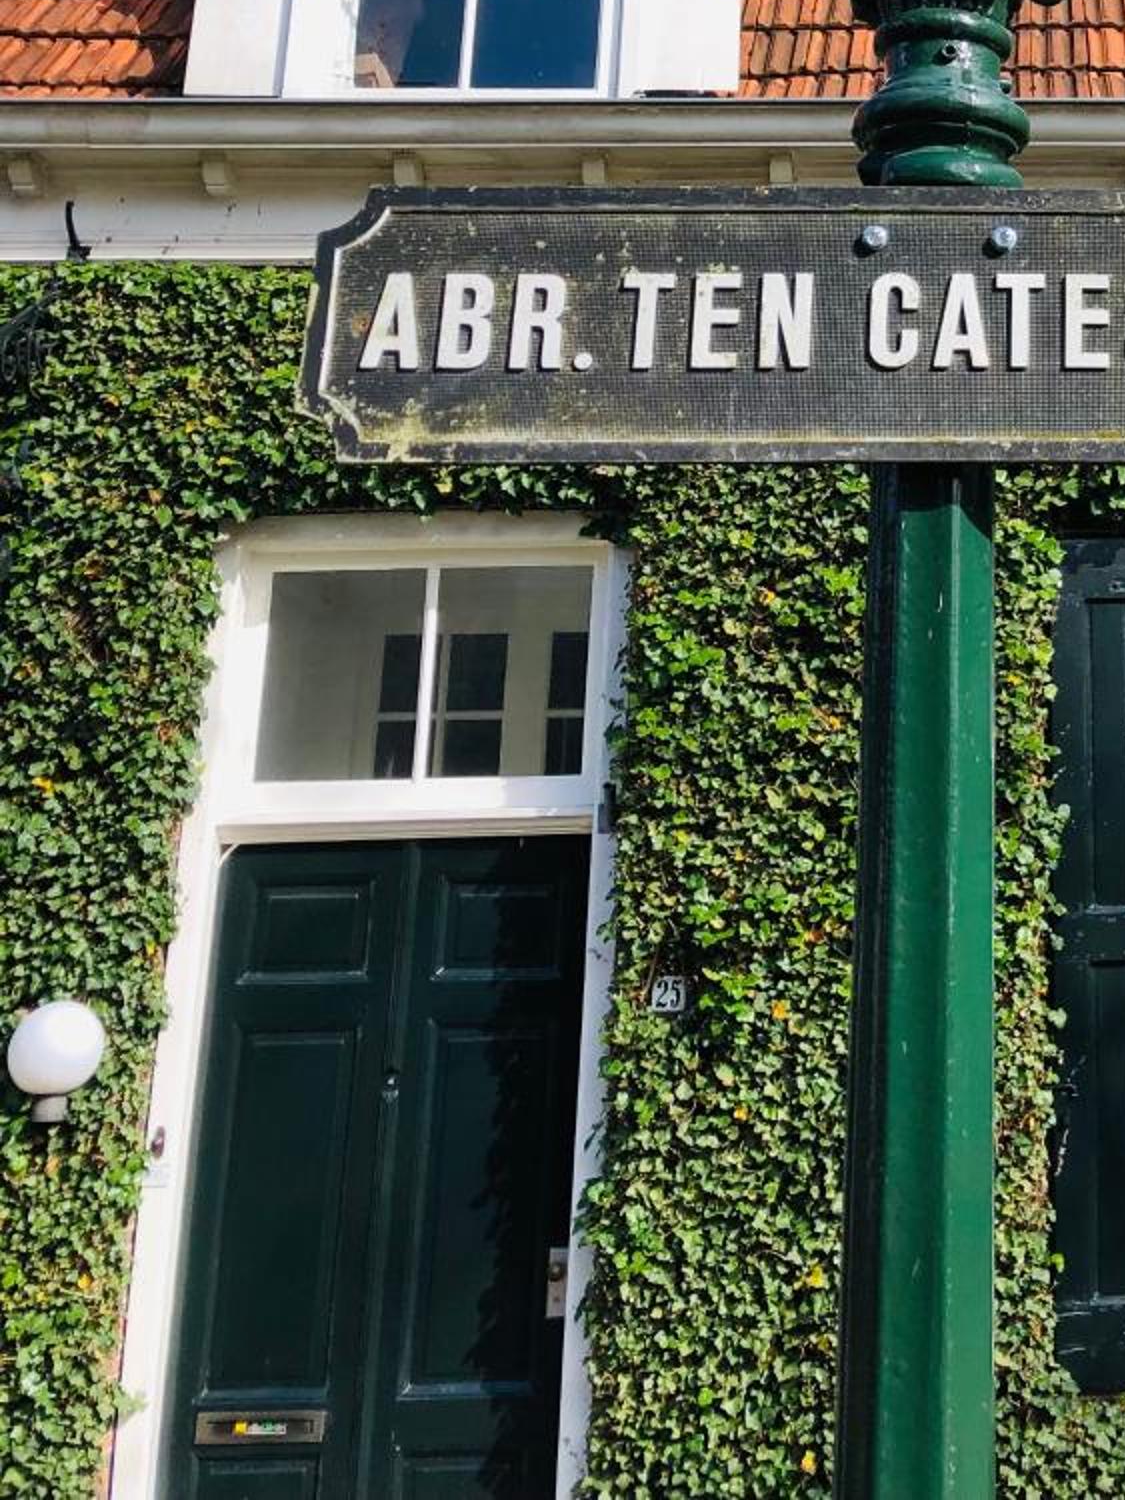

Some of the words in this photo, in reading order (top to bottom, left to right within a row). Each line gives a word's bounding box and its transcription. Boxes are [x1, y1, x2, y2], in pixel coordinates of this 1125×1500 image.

[359, 273, 593, 371] ABR.
[621, 272, 815, 370] TEN
[655, 980, 682, 1008] 25
